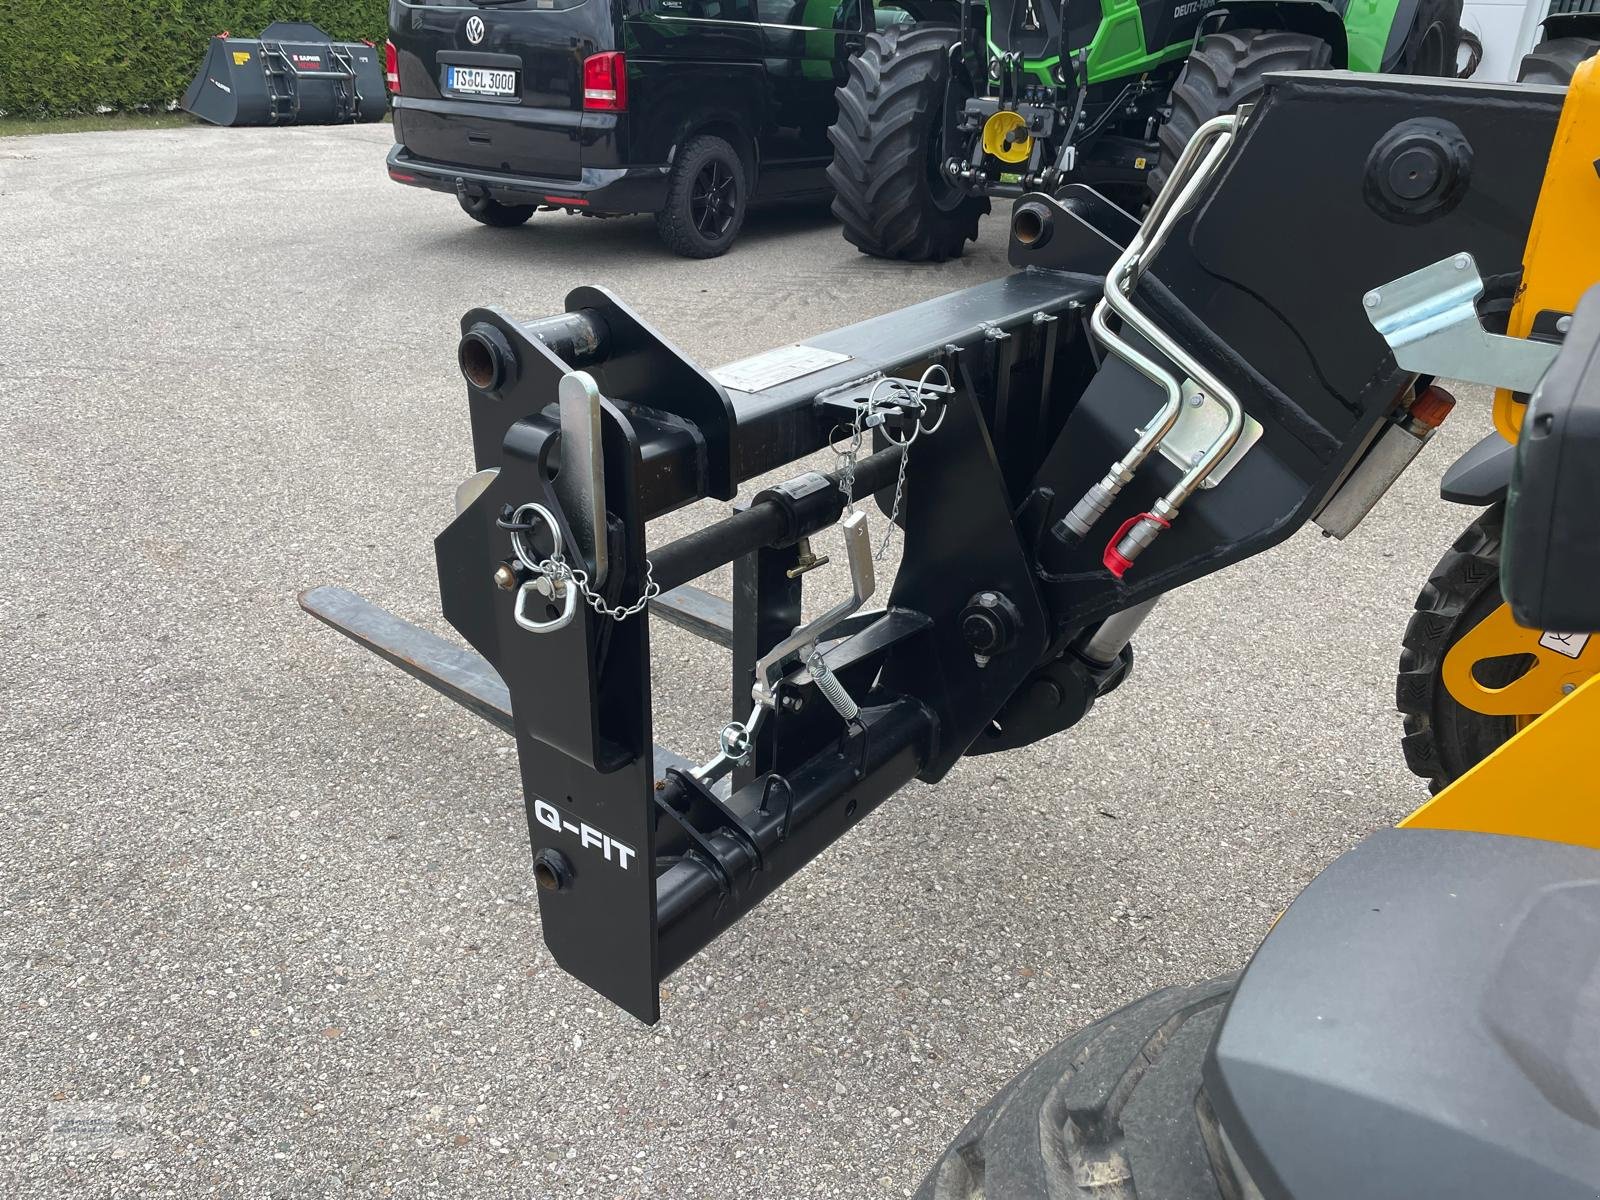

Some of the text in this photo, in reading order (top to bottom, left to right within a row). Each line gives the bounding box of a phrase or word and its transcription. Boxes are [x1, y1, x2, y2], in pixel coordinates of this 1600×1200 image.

[455, 70, 514, 91] TS CL 3000
[534, 799, 636, 870] Q-FIT
